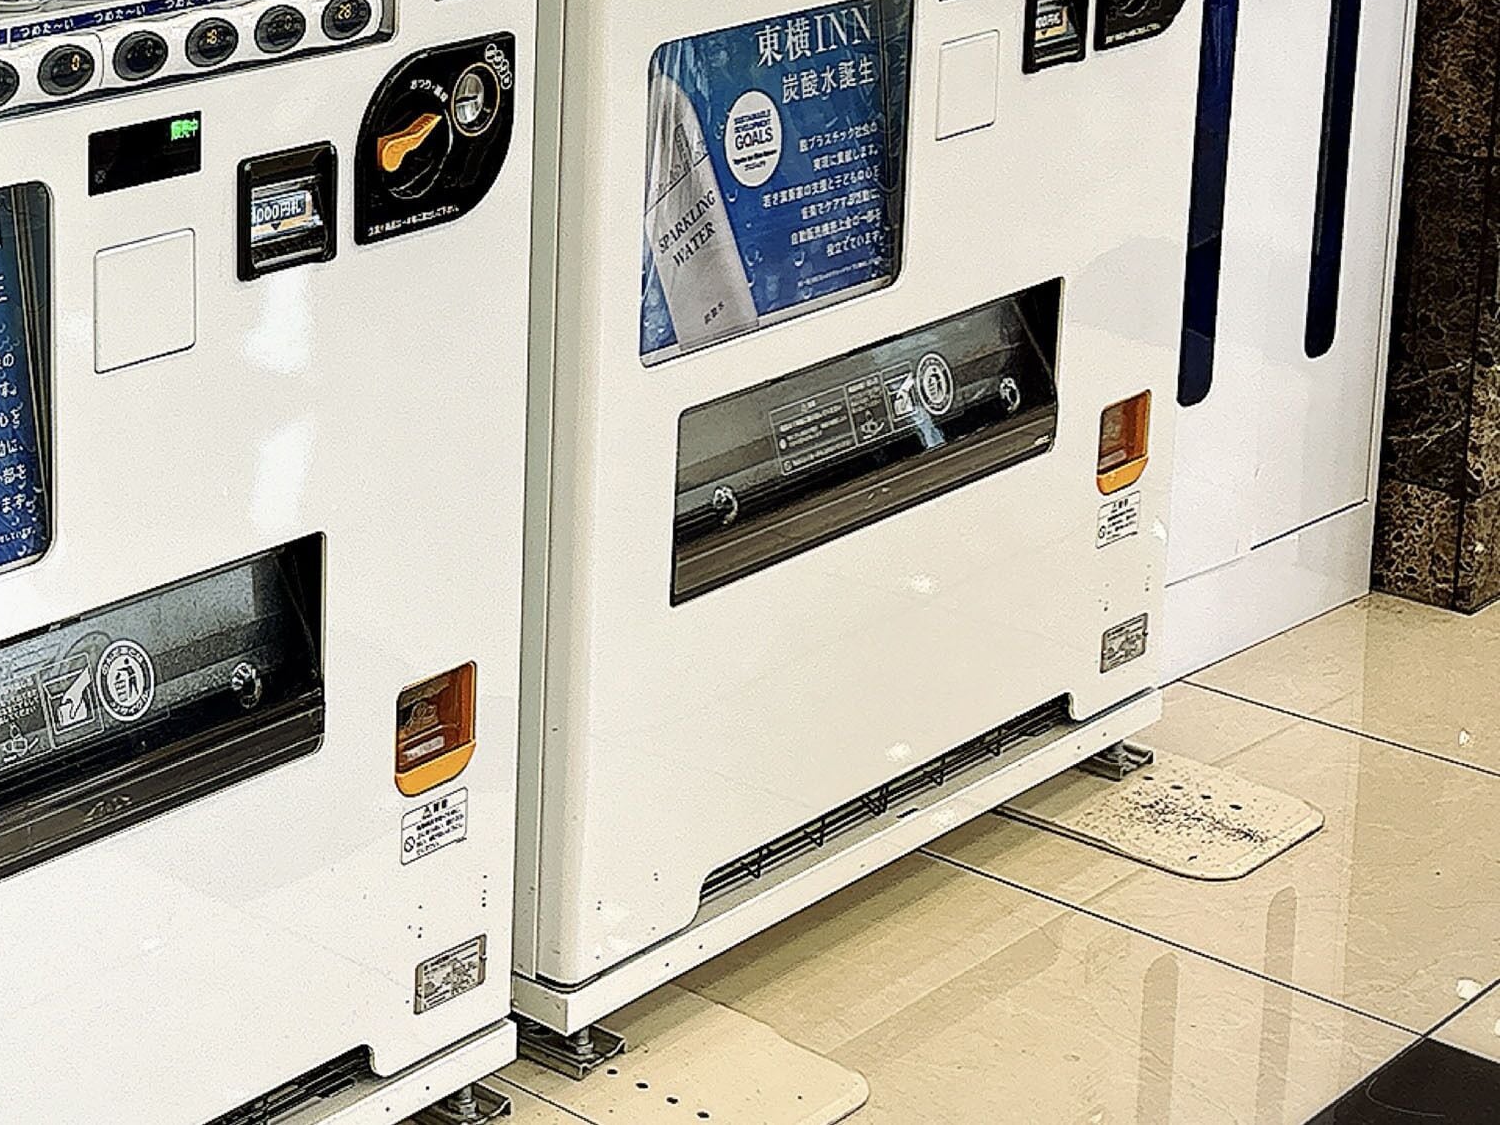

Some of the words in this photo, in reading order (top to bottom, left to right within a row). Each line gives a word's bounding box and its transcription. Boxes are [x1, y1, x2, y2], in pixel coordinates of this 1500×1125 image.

[755, 5, 871, 68] 東横INN
[782, 56, 875, 104] 炭酸水誕生
[735, 127, 774, 150] GOALS
[658, 189, 716, 254] SPARKLING
[672, 221, 716, 268] WATER
